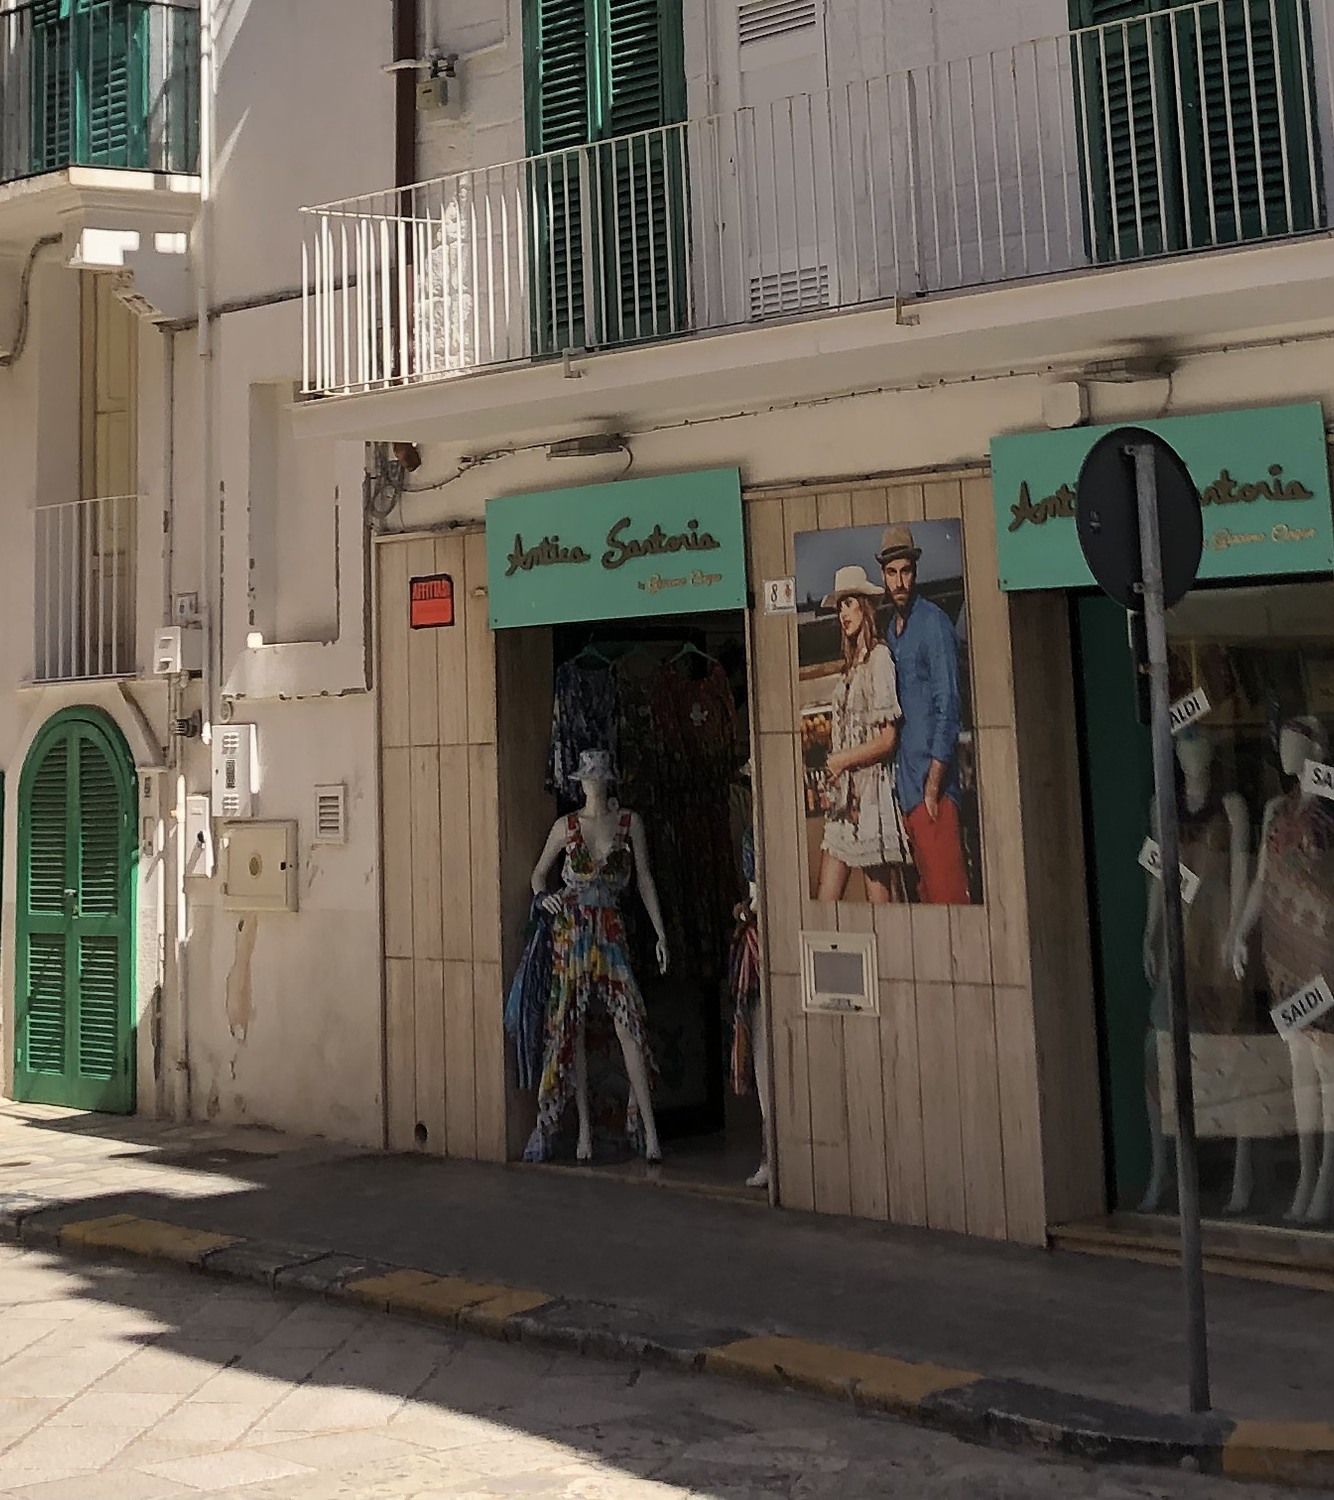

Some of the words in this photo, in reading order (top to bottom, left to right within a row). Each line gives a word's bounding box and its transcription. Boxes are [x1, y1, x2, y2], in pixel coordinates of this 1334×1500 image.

[1008, 480, 1079, 532] Ant
[1199, 464, 1315, 507] rtoria
[505, 533, 592, 576] Antica
[770, 583, 778, 602] 8
[1169, 695, 1201, 729] ALDI
[1280, 987, 1324, 1028] SALDI
